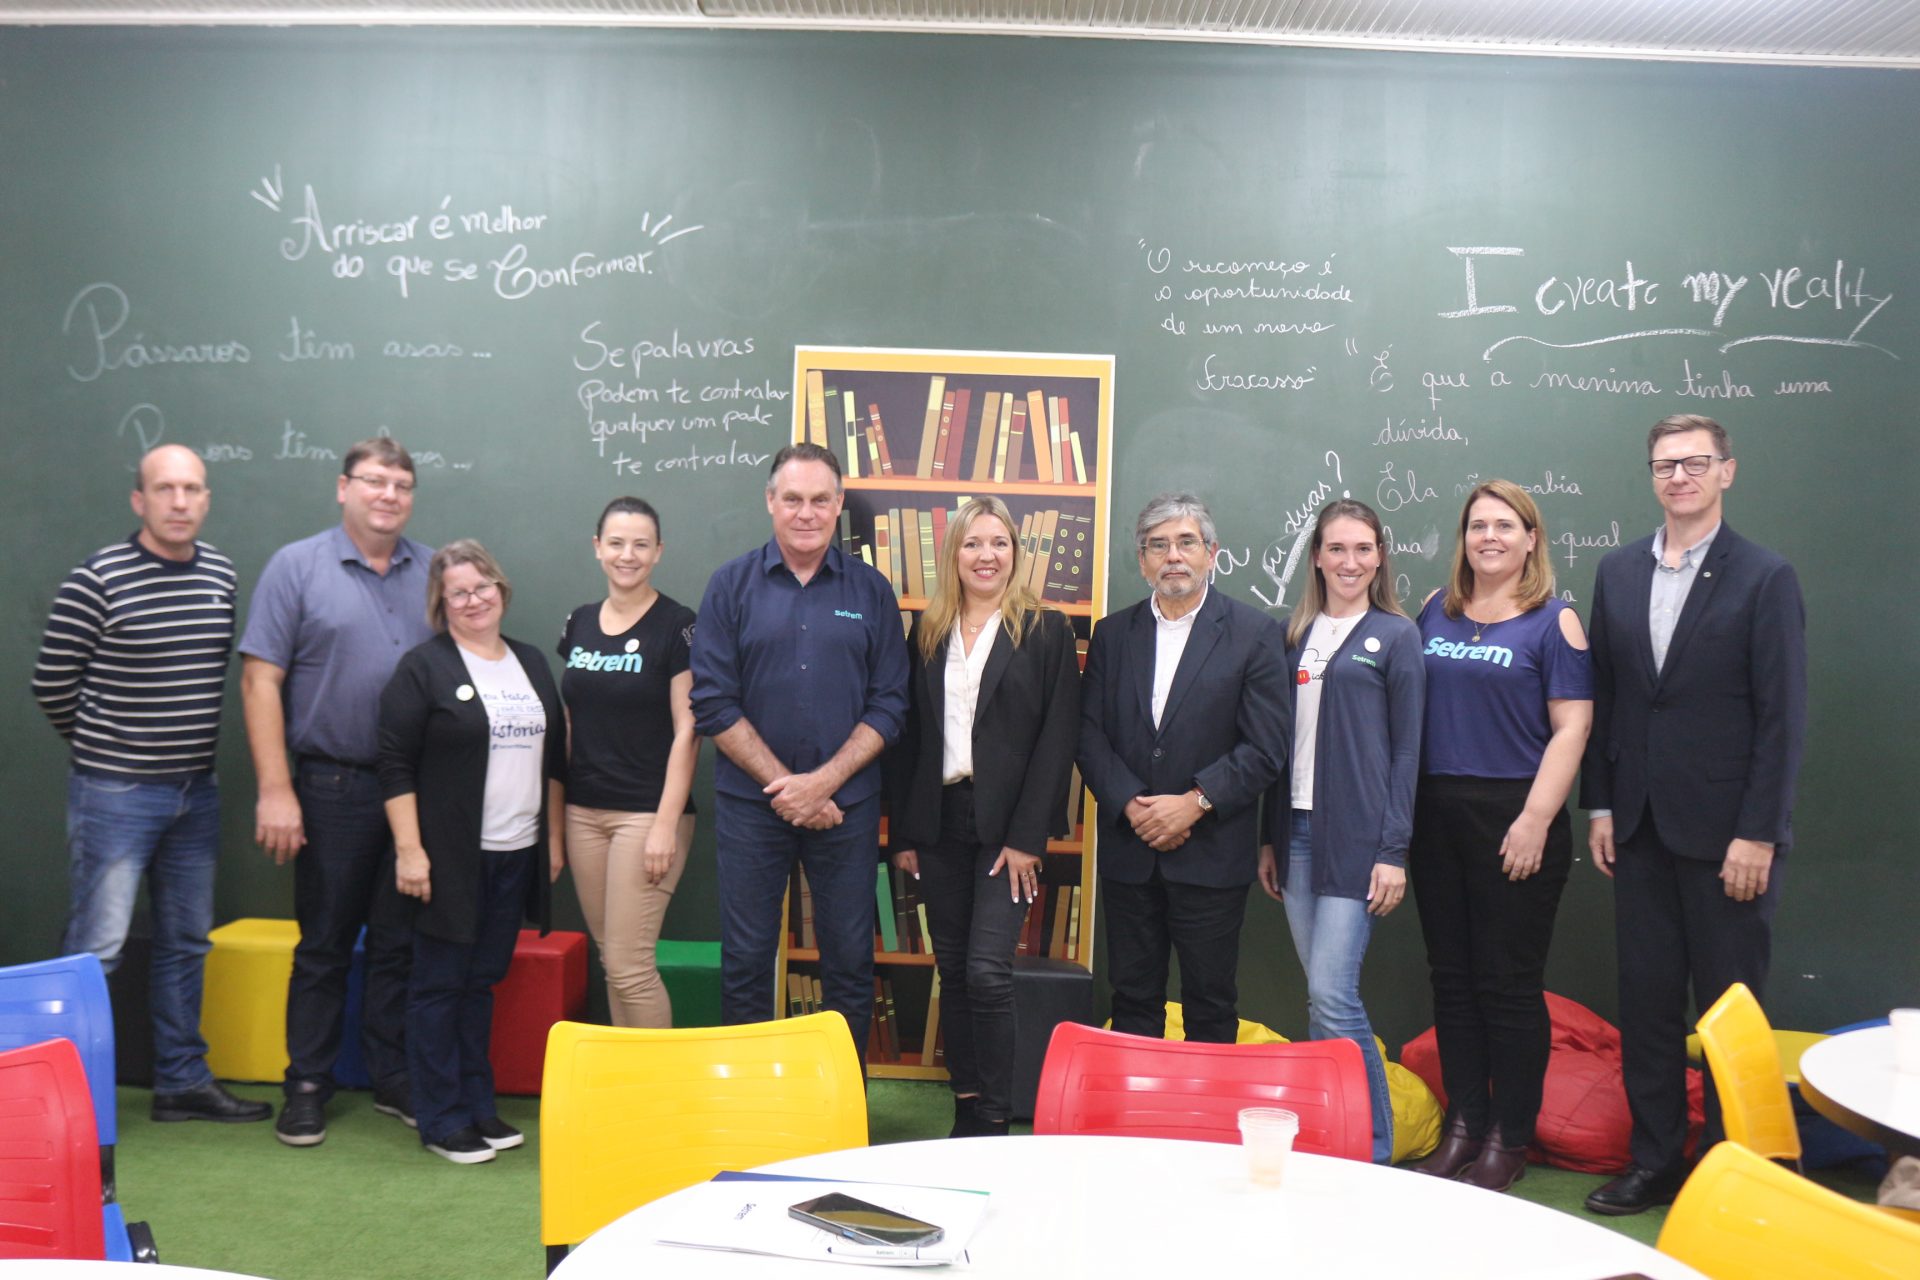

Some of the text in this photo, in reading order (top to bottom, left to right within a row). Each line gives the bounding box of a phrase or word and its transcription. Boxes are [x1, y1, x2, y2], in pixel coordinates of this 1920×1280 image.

[280, 184, 548, 261] Arriscar é melhor
[332, 253, 364, 279] do
[387, 255, 433, 298] que
[444, 259, 478, 281] se
[1182, 259, 1311, 280] recomeço
[1318, 252, 1337, 276] é
[1438, 247, 1526, 318] I
[1681, 271, 1748, 327] my
[62, 281, 251, 382] Pássaros
[1161, 312, 1186, 336] de
[1202, 322, 1243, 335] um
[573, 320, 755, 379] Se palavras
[1422, 371, 1470, 411] que
[1491, 371, 1512, 386] a
[1530, 367, 1662, 395] menina
[1675, 359, 1755, 399] tinha
[1774, 379, 1833, 395] uma
[591, 411, 675, 457] qualquer
[682, 415, 716, 430] um
[612, 439, 771, 476] te controlar
[1552, 520, 1621, 568] qual
[566, 646, 643, 673] Setrem
[1352, 654, 1377, 668] Setrem
[1424, 637, 1513, 668] Setrem
[491, 720, 546, 739] istória
